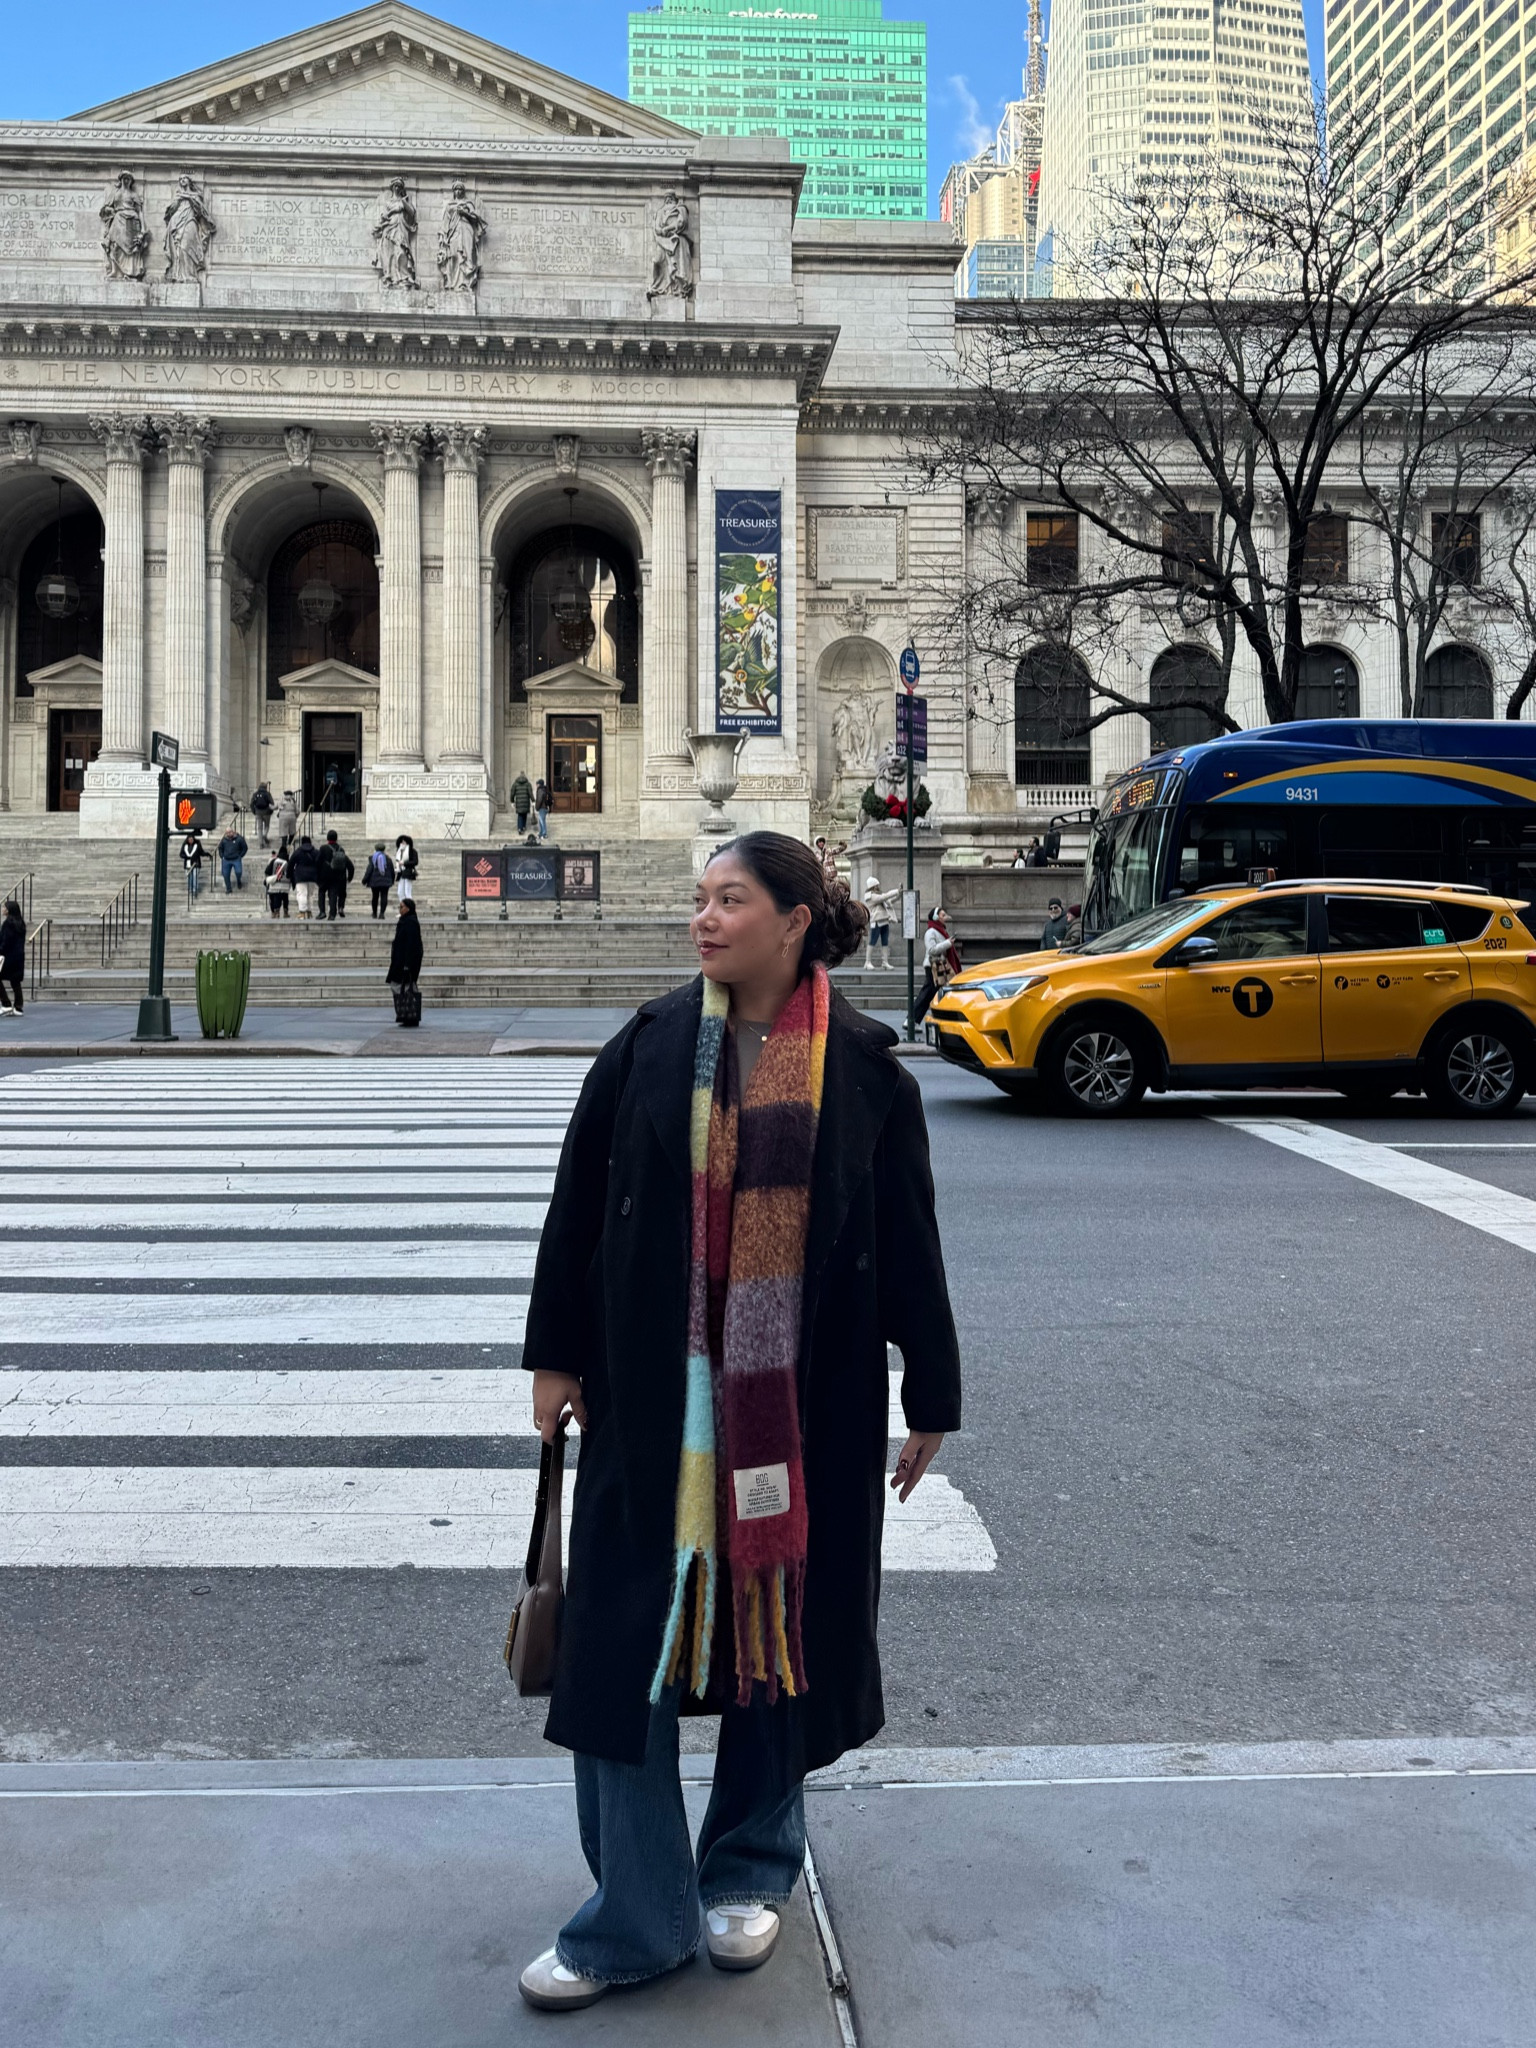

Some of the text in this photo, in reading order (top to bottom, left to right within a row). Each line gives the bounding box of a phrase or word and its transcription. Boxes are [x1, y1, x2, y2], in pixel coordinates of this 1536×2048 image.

[36, 194, 94, 208] LIBRARY
[220, 200, 369, 216] THE LENOX LIBRARY
[491, 208, 636, 224] THE TILDEN TRUST
[40, 221, 74, 230] ASTOR
[253, 226, 336, 237] JAMES LENOX
[50, 241, 98, 249] KNOWLEDGE
[240, 236, 287, 246] DEDICATED
[311, 238, 349, 247] HISTORY
[218, 245, 273, 254] LITERATURE
[42, 364, 99, 382] THE
[120, 364, 188, 384] NEW
[212, 367, 282, 386] YORK
[306, 370, 401, 390] PUBLIC
[427, 373, 537, 394] LIBRARY
[720, 518, 777, 528] TREASURES
[1286, 787, 1318, 801] 9431
[1424, 929, 1444, 937] curb
[1484, 937, 1507, 950] 2027
[1241, 985, 1263, 1012] T
